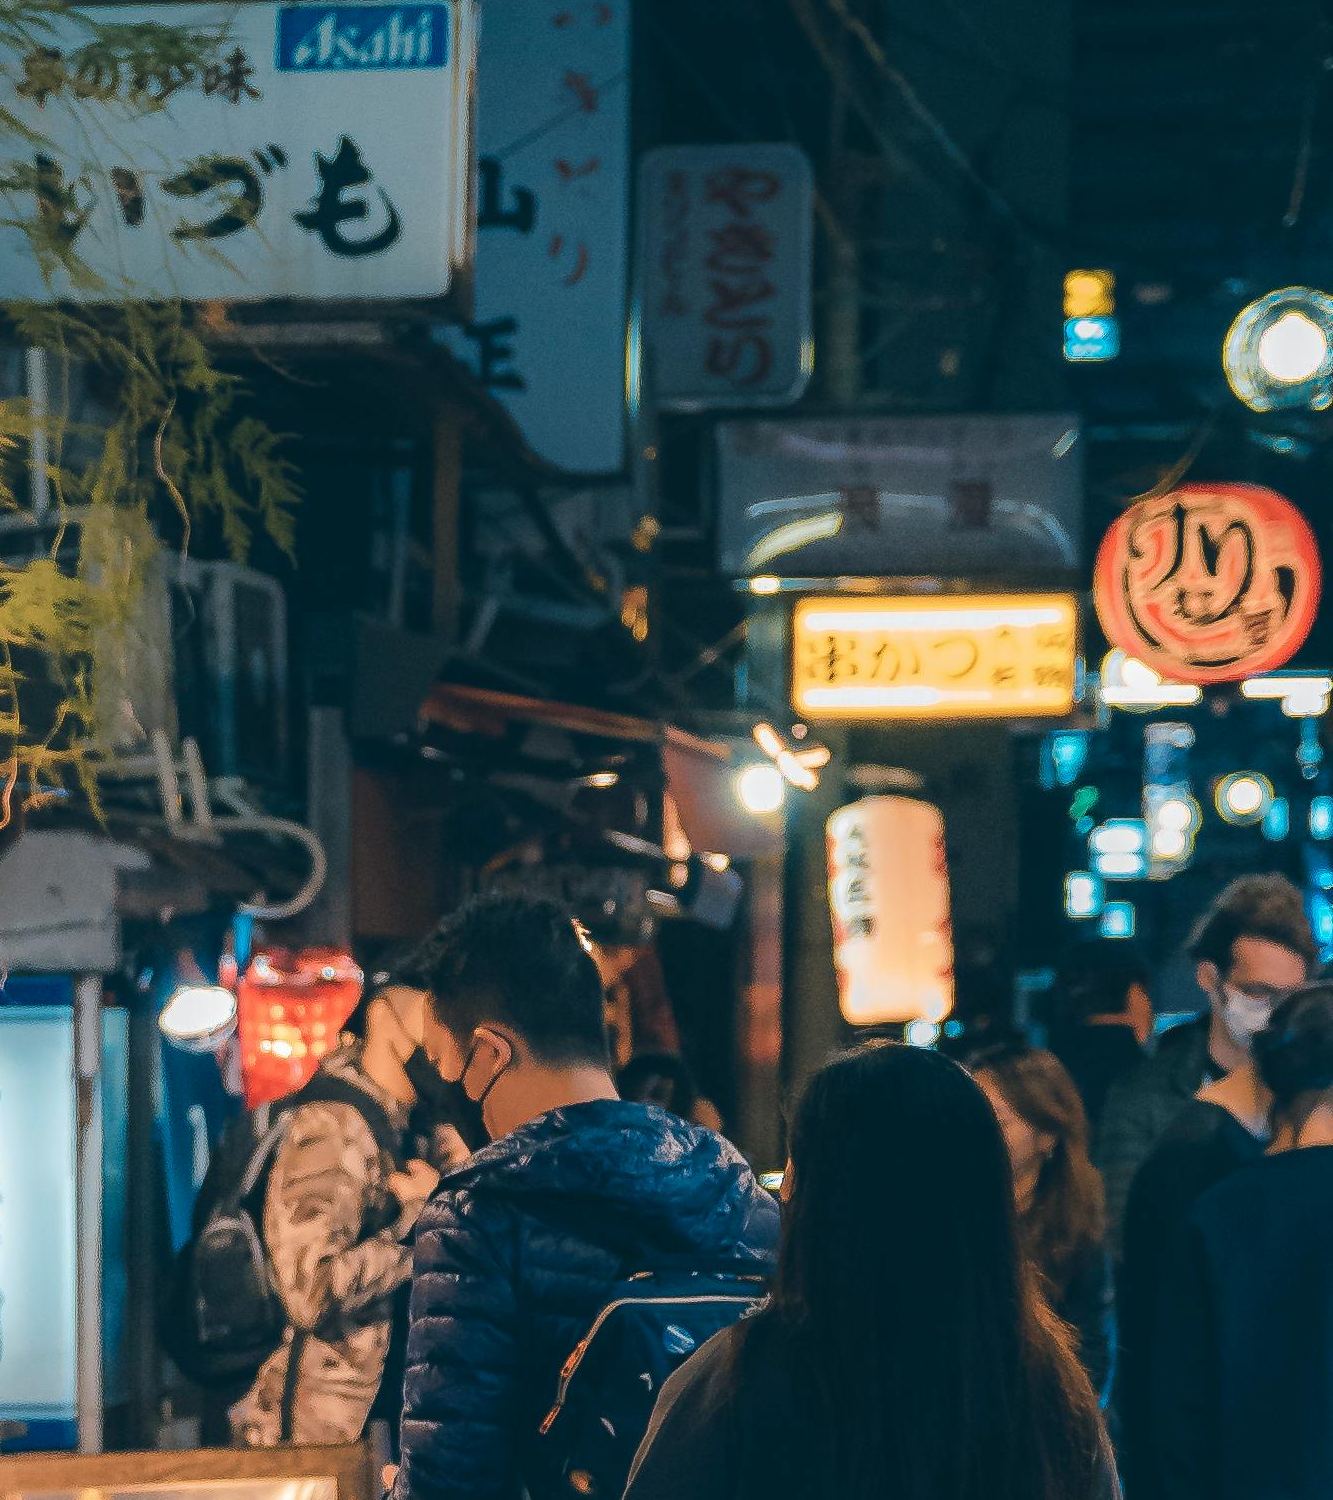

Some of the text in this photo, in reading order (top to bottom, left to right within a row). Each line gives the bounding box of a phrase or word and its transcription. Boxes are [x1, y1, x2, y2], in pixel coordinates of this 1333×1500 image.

[293, 11, 432, 69] Asahi
[33, 132, 403, 260] いづも
